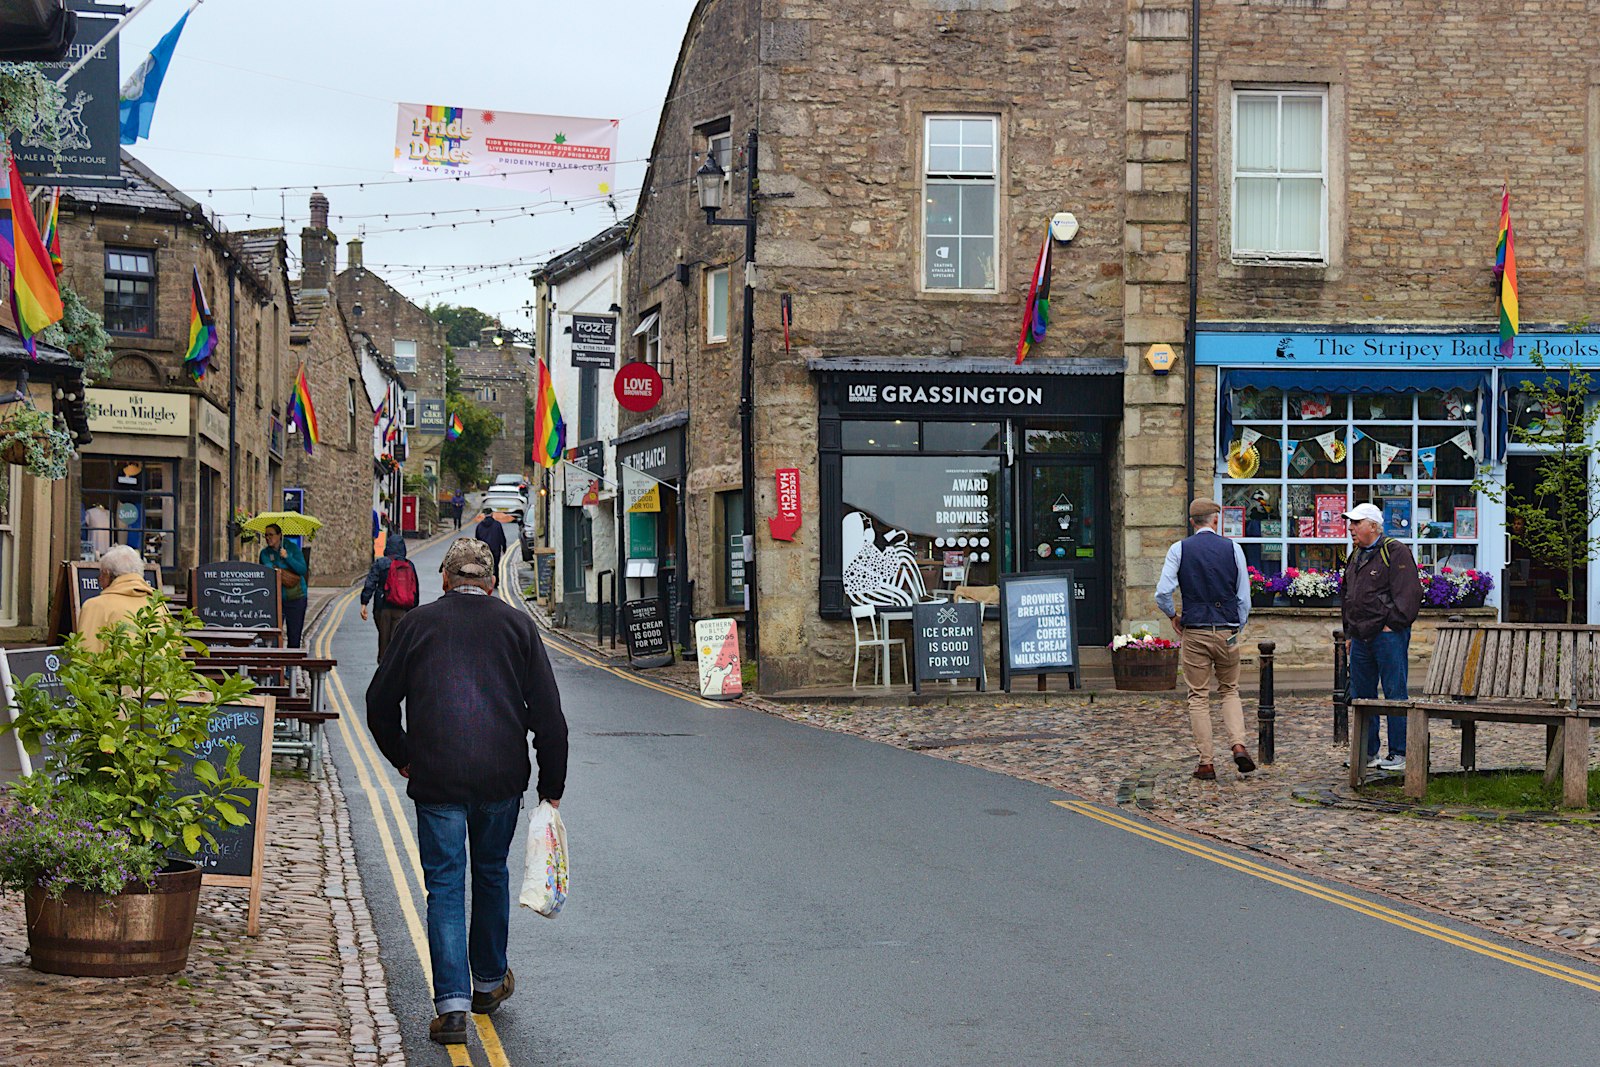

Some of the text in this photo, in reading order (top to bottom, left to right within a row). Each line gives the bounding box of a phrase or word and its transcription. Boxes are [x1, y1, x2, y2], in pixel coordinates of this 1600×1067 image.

[412, 117, 473, 141] Pride
[503, 141, 541, 150] WORKSHOPS
[409, 139, 472, 165] Dales
[504, 148, 555, 157] ENTERTAINMENT
[80, 157, 107, 165] HOUSE
[1314, 338, 1356, 356] The
[1363, 338, 1444, 361] Stripey
[1536, 340, 1599, 357] Books
[623, 378, 653, 390] LOVE
[623, 389, 653, 397] BROWNIES
[849, 385, 1042, 405] LOVE GRASSINGTON
[131, 406, 177, 425] Midgley
[421, 417, 445, 425] HOUSE
[645, 446, 666, 469] HATCH
[952, 479, 988, 491] AWARD
[637, 488, 655, 496] CREAM
[780, 472, 791, 511] HATCH
[943, 495, 988, 507] WINNING
[119, 510, 136, 518] Sale
[936, 511, 989, 524] BROWNIES
[204, 571, 265, 579] THE DEVONSHIRE
[82, 578, 99, 590] THE
[1021, 593, 1065, 606] BROWNIES
[1018, 605, 1066, 617] BREAKFAST
[630, 620, 664, 632] ICE CREAM
[700, 621, 732, 629] NORTHERN
[1037, 616, 1067, 628] LUNCH
[634, 630, 661, 640] IS GOOD
[700, 633, 735, 642] FOR DOGS
[923, 626, 974, 638] ICE CREAM
[1037, 628, 1067, 640] COFFEE
[635, 638, 663, 648] FOR YOU
[929, 641, 969, 653] IS GOOD
[1021, 640, 1067, 653] ICE CREAM
[928, 655, 970, 668] FOR YOU
[1014, 651, 1068, 665] MILKSHAKES
[207, 711, 260, 733] GRAFTERS
